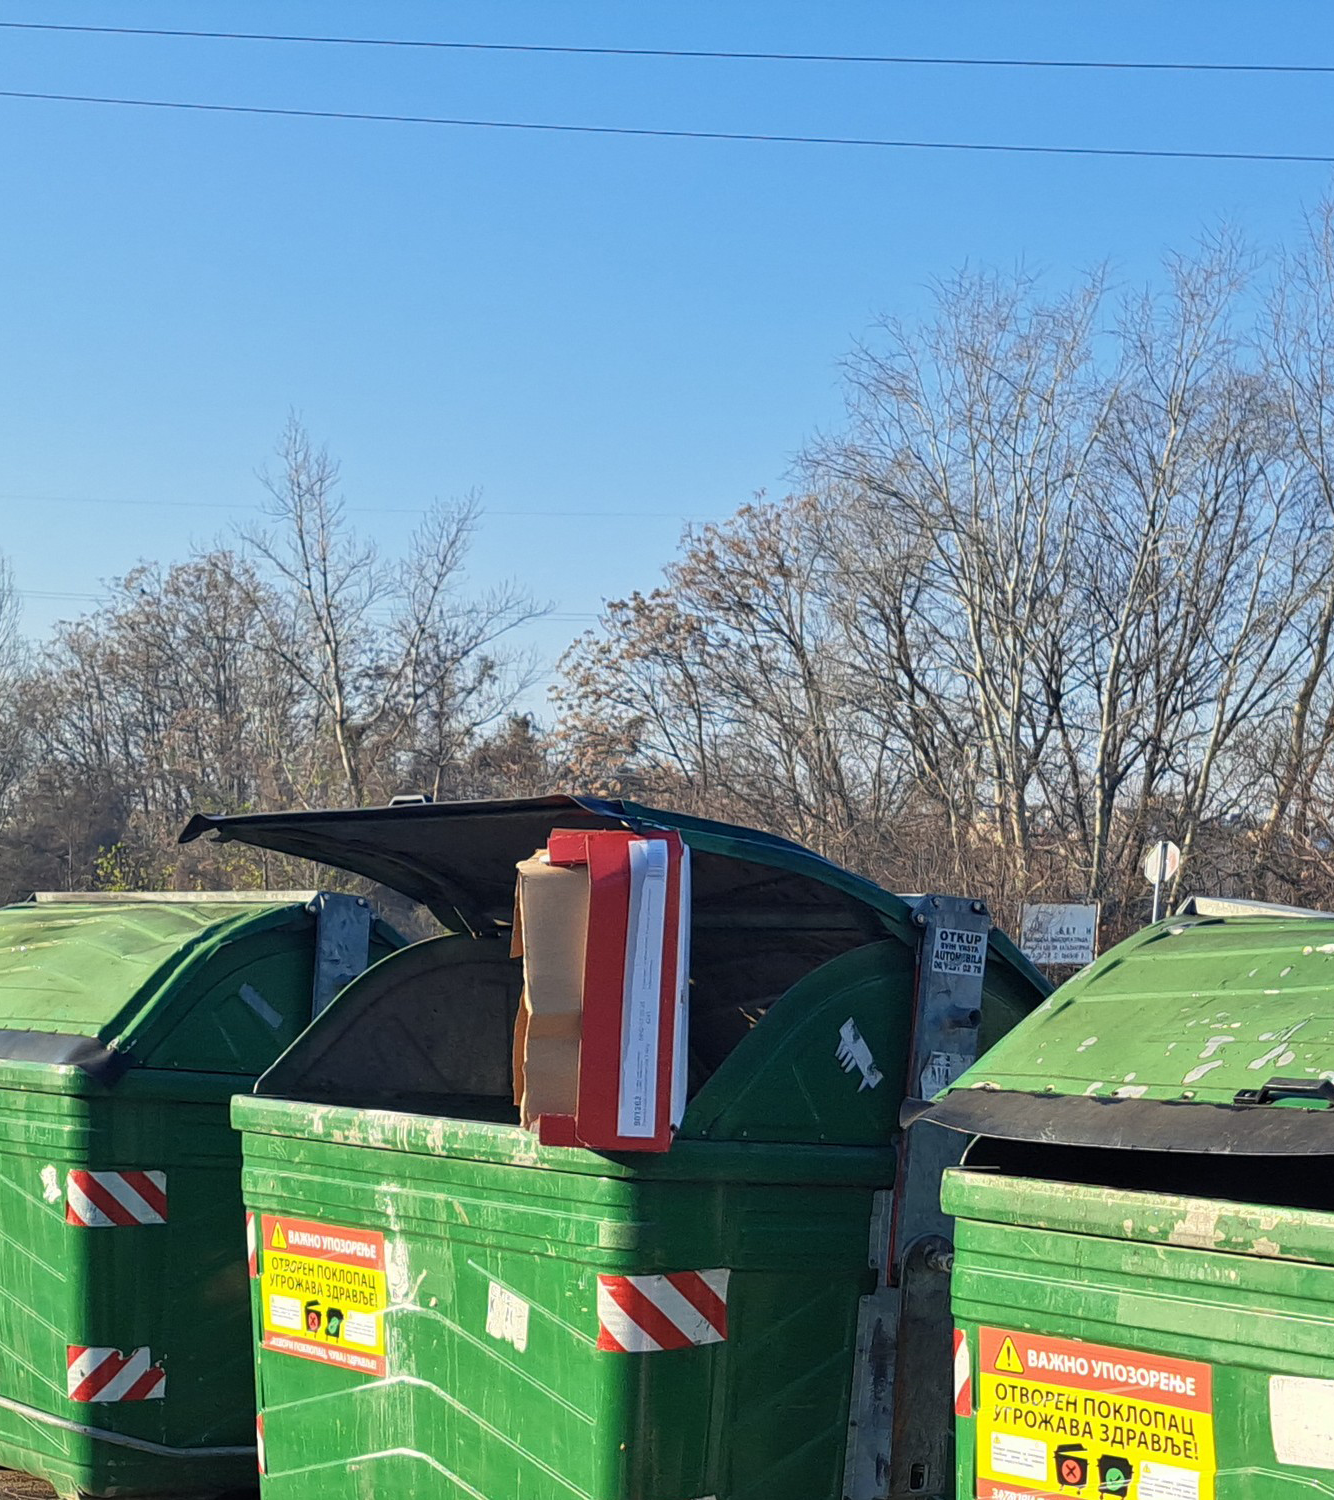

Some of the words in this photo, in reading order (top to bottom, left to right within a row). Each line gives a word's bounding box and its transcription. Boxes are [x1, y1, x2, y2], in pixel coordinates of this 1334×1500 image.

[940, 930, 982, 945] OTKUP
[288, 1230, 321, 1248] ВАЖНО
[322, 1236, 376, 1258] УПОЗОРЕЊЕ
[270, 1273, 324, 1297] УГРОЖАВА
[325, 1284, 378, 1308] ЗДРАВЉЕ!
[271, 1257, 314, 1277] ОТВОРЕН
[317, 1265, 376, 1290] ПОКЛОПАЦ
[1027, 1349, 1089, 1376] ВАЖНО
[1091, 1359, 1196, 1396] УПОЗОРЕЊЕ
[995, 1382, 1078, 1413] ОТВОРЕН
[1084, 1398, 1195, 1436] ПОКЛОПАЦ
[993, 1405, 1094, 1440] УГРОЖАВА
[1099, 1423, 1199, 1460] ЗДРАВЉЕ!
